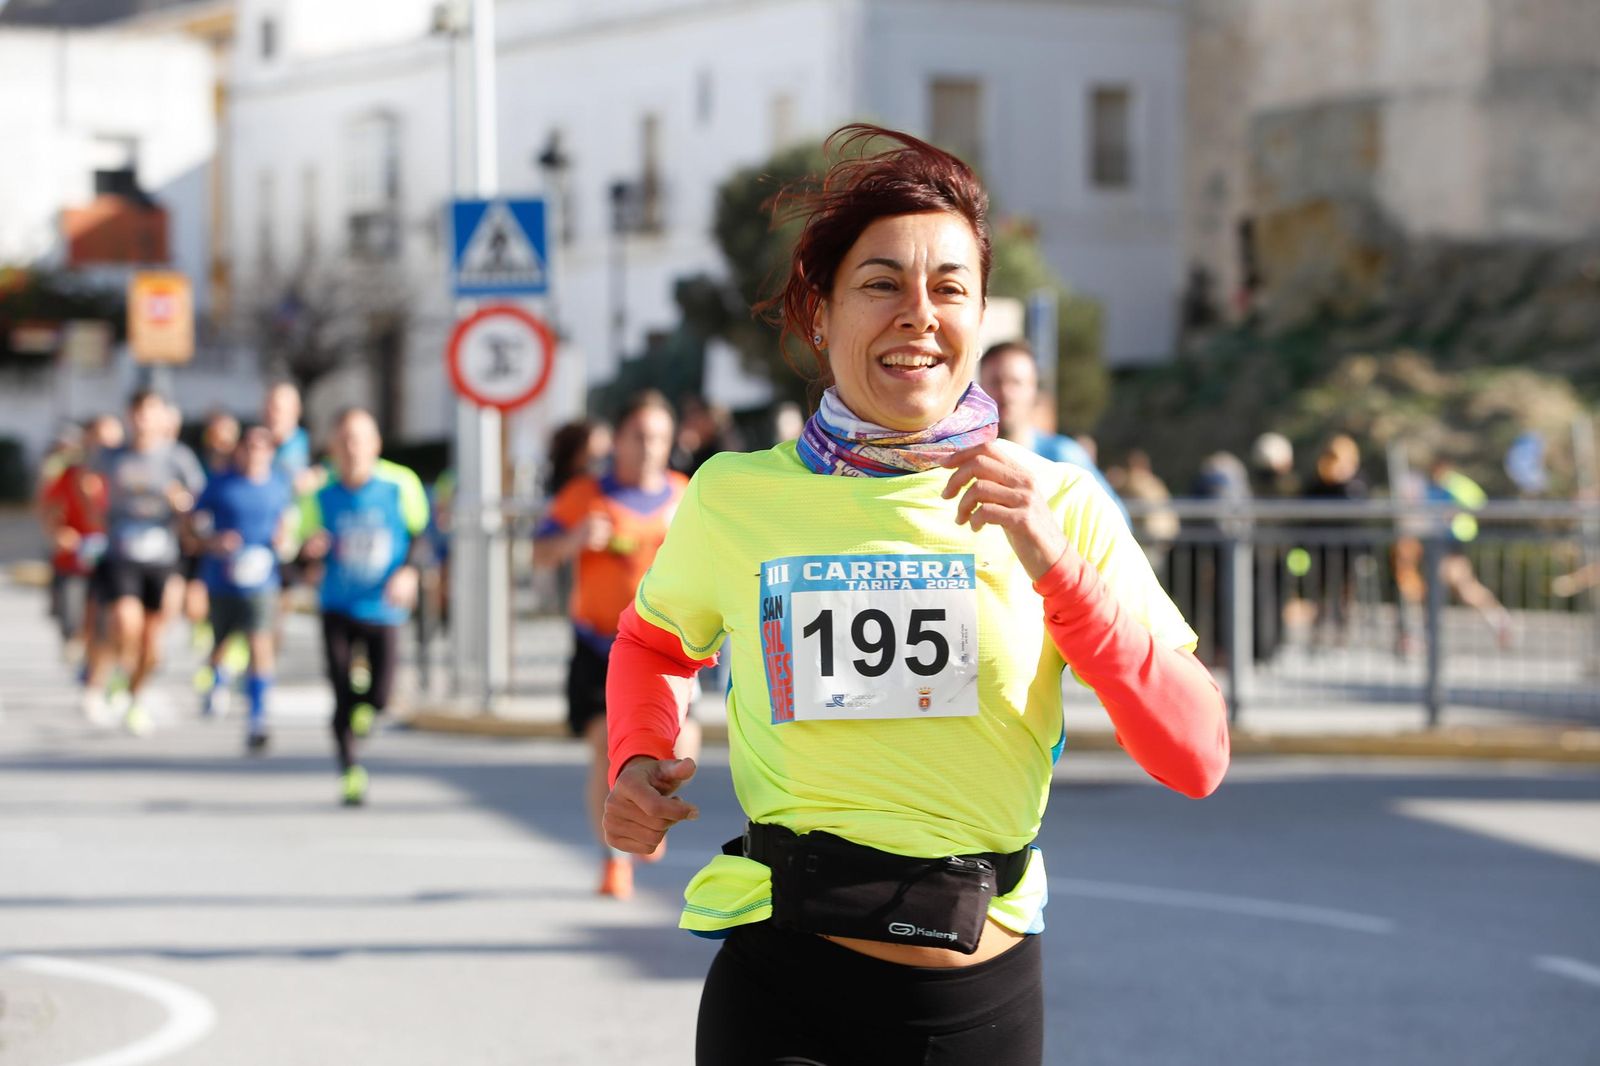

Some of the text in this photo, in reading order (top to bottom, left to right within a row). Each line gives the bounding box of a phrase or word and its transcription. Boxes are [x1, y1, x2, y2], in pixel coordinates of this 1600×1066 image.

[767, 561, 969, 586] III CARRERA
[846, 580, 969, 590] TARIFA 2024
[763, 595, 783, 622] SAN
[763, 621, 785, 655] SIL
[803, 609, 949, 677] 195
[917, 928, 958, 942] Kalenji
